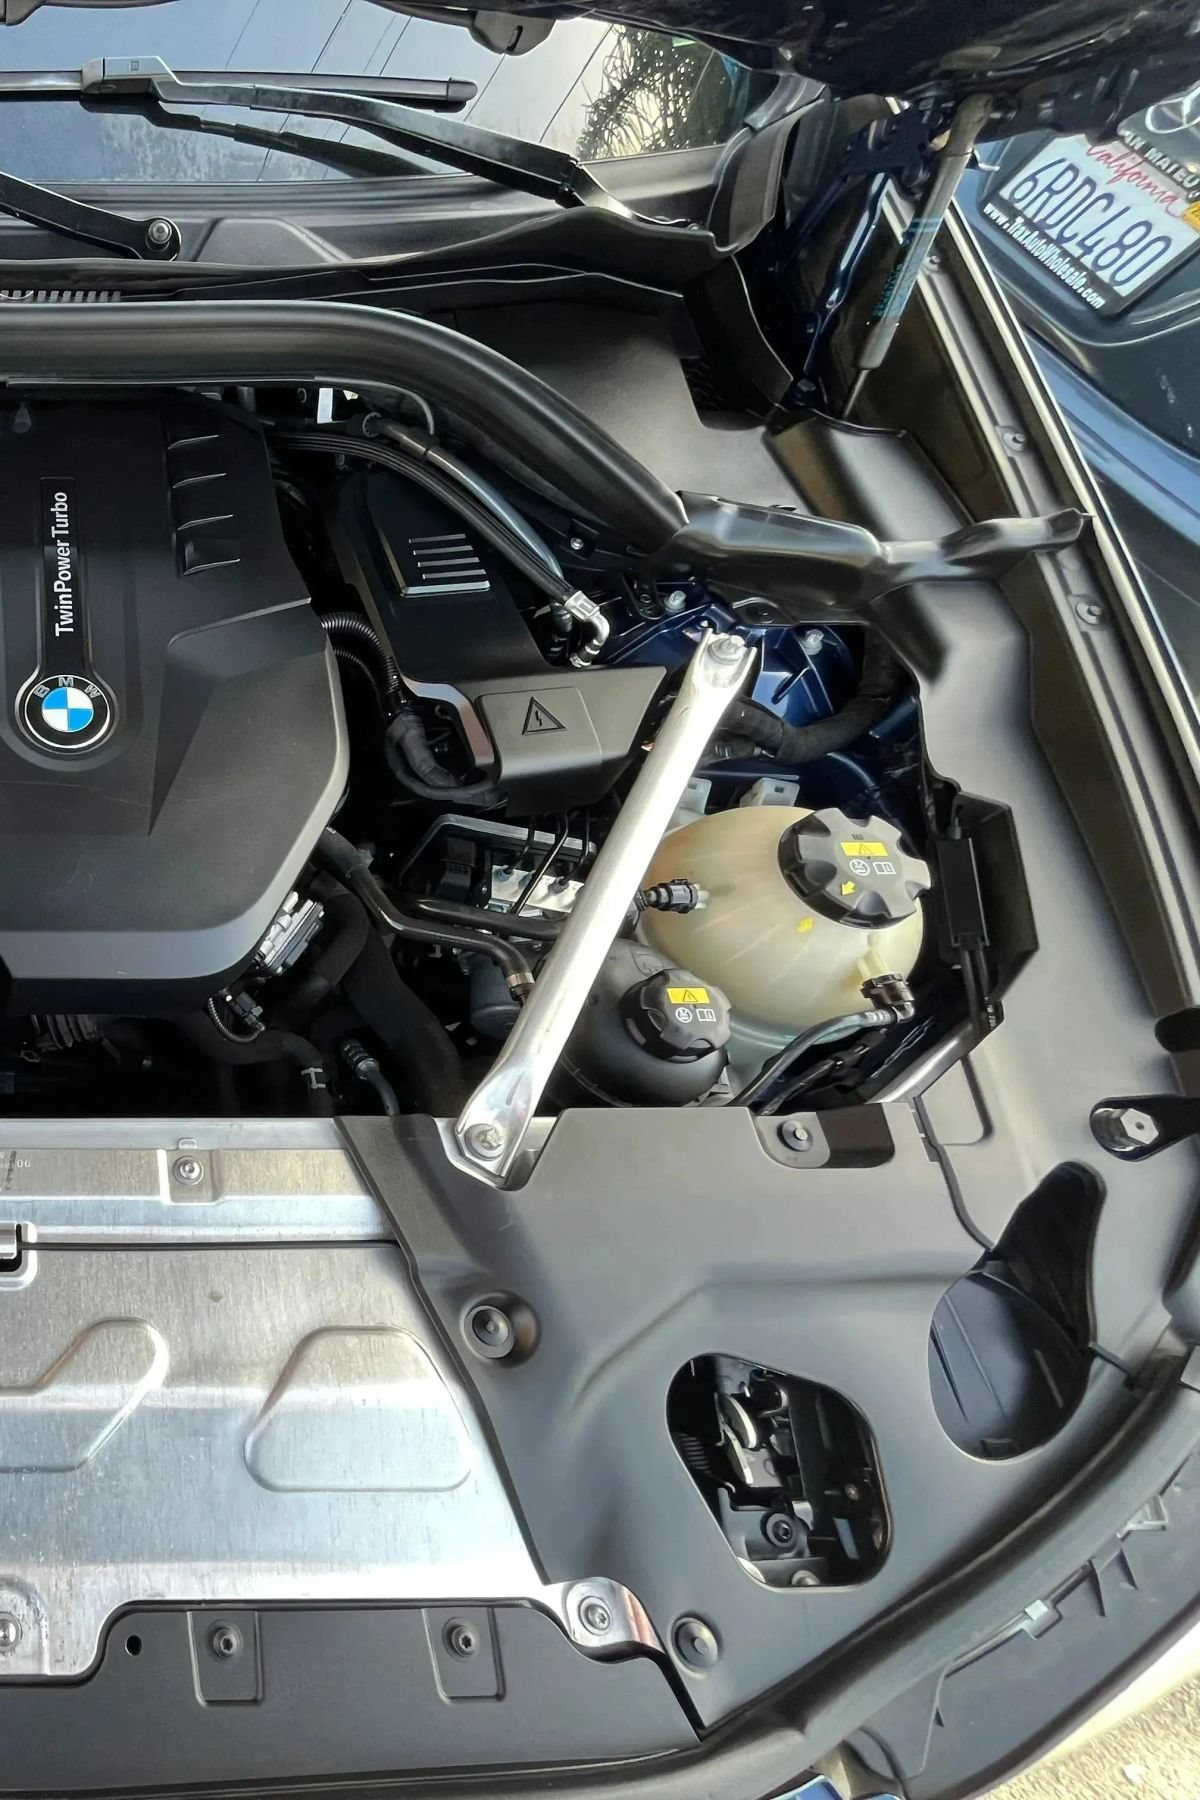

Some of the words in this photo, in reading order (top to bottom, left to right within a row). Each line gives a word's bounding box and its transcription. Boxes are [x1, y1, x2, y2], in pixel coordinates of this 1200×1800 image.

[983, 202, 1107, 310] www.TraxAutoWholesale.com
[1008, 157, 1172, 287] 6RDC480
[33, 676, 101, 699] BMW
